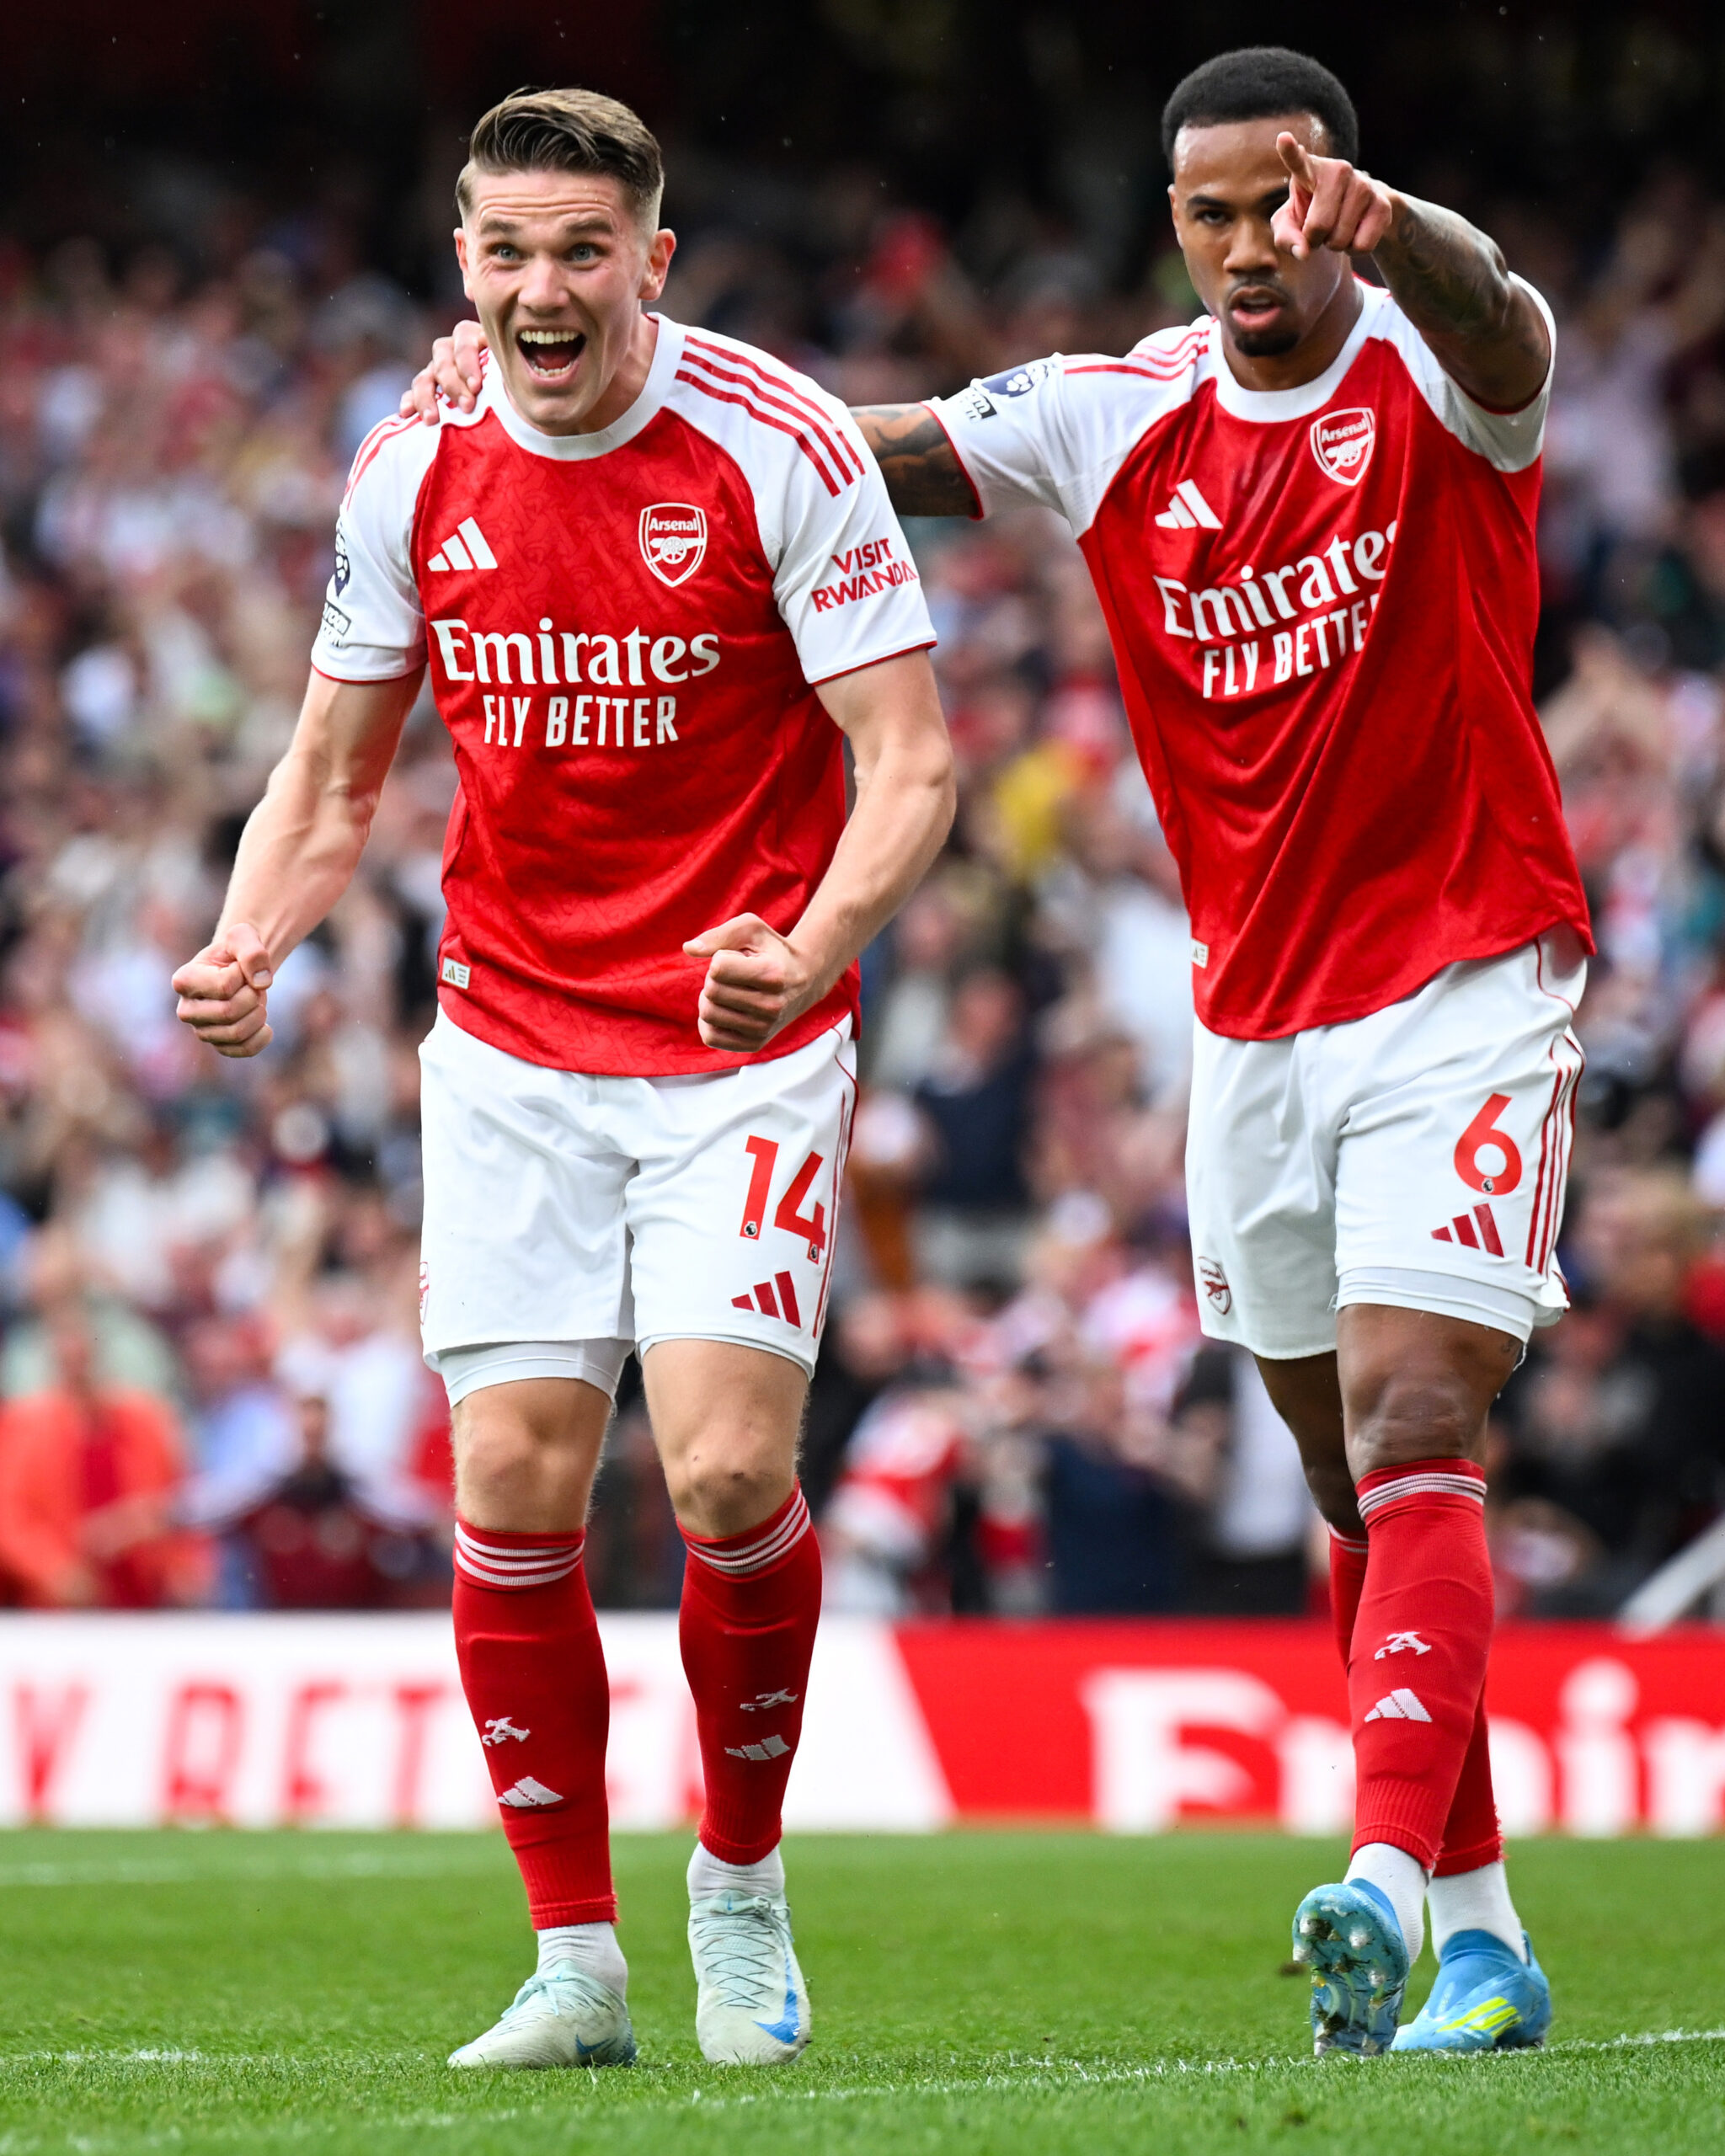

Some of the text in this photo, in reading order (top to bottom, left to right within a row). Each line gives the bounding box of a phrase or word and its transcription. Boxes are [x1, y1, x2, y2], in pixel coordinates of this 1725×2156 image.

[1321, 417, 1369, 443] Arsenal
[649, 517, 698, 531] Arsenal
[810, 560, 919, 613] RWANDA
[830, 537, 893, 574] VISIT
[1152, 519, 1397, 642] Emirate
[430, 616, 721, 686] Emirates
[1203, 592, 1380, 698] FLY BETTE
[483, 694, 679, 748] FLY BETTER
[1454, 1092, 1522, 1196] 6
[739, 1134, 826, 1265] 14
